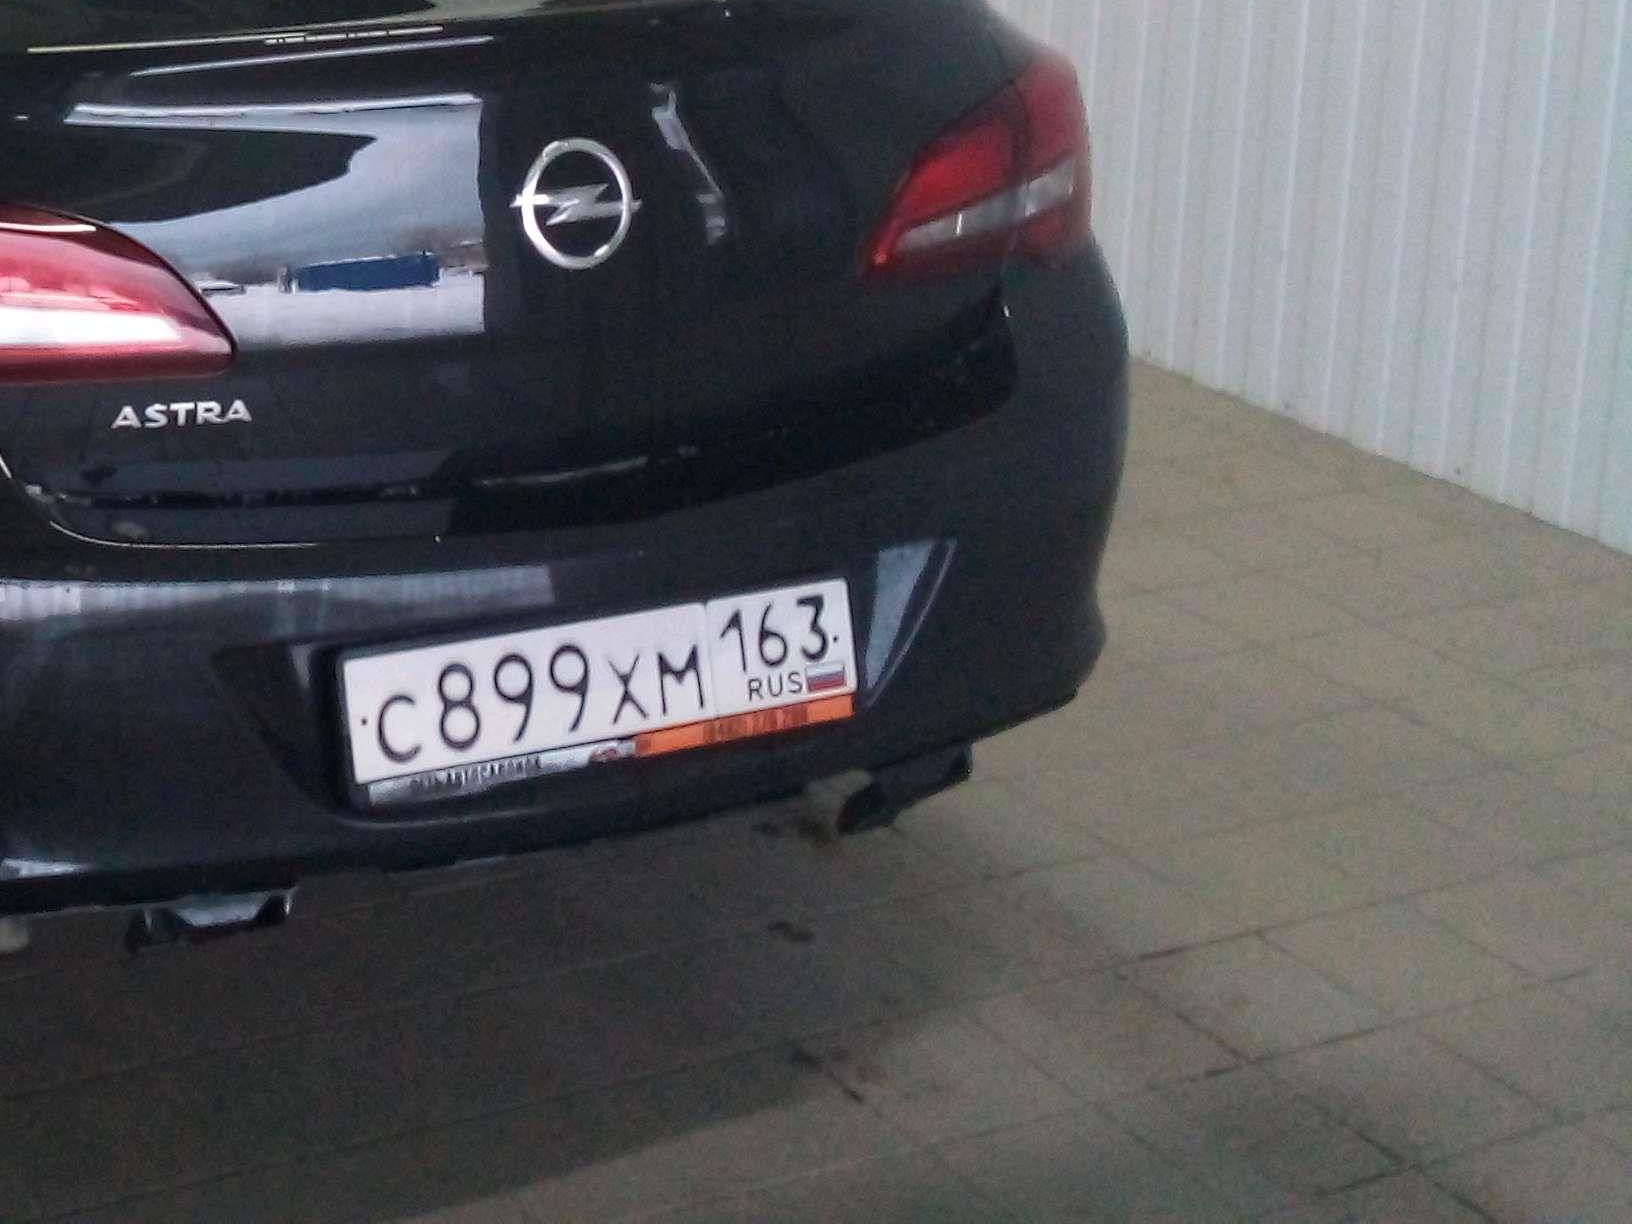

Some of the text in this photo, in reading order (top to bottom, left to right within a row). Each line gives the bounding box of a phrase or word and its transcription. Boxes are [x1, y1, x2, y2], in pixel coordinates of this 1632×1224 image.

[111, 399, 253, 429] ASTRA
[720, 595, 827, 672] 163
[748, 671, 803, 702] RUS
